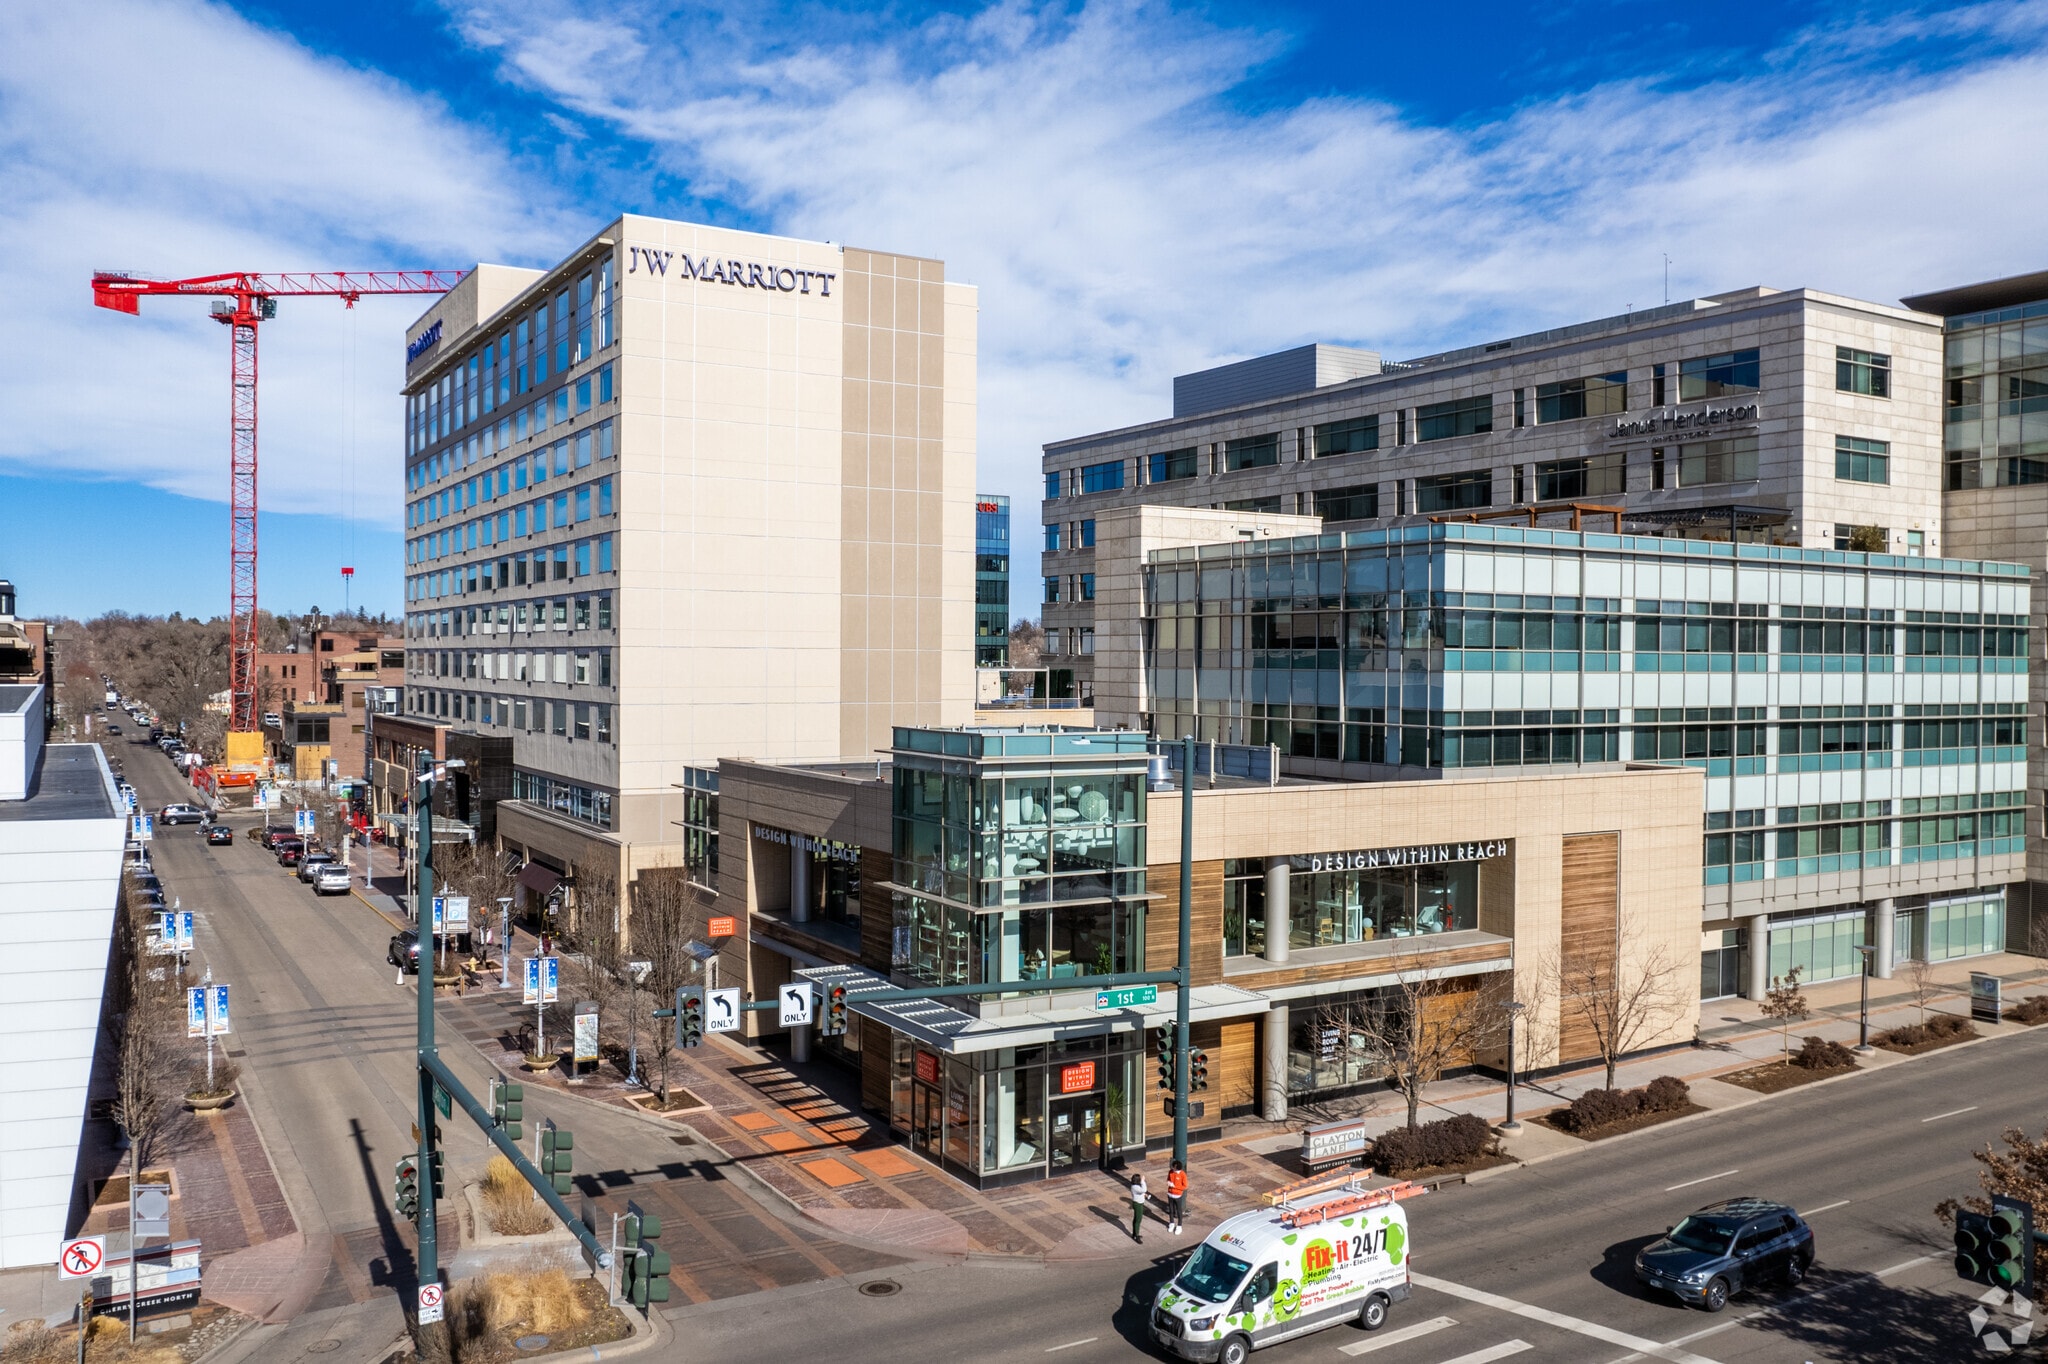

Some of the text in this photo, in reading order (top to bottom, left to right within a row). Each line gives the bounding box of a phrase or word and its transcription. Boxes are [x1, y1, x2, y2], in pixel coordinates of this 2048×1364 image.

[628, 246, 836, 297] JW MARRIOTT
[1609, 404, 1760, 438] Janus Henderson
[977, 501, 998, 513] UBS
[755, 826, 858, 863] DESIGN WITHIN REACH
[1312, 843, 1507, 872] DESIGN WITHIN REACH
[1117, 991, 1134, 1005] 1st
[710, 1018, 734, 1029] ONLY
[784, 1012, 807, 1023] ONLY
[1313, 1130, 1363, 1148] CLAYTON
[1313, 1143, 1346, 1158] LANE
[1306, 1228, 1388, 1271] Fix-it 24/7
[1307, 1266, 1336, 1279] Heating
[1353, 1255, 1378, 1266] Electric
[1307, 1273, 1341, 1287] Plumbing
[1300, 1290, 1319, 1299] House
[1328, 1280, 1353, 1292] Trouble?
[1300, 1299, 1312, 1307] Call
[1326, 1291, 1343, 1300] Green
[1345, 1285, 1365, 1294] Bubble
[135, 1298, 161, 1309] CREEK
[163, 1293, 193, 1304] NORTH
